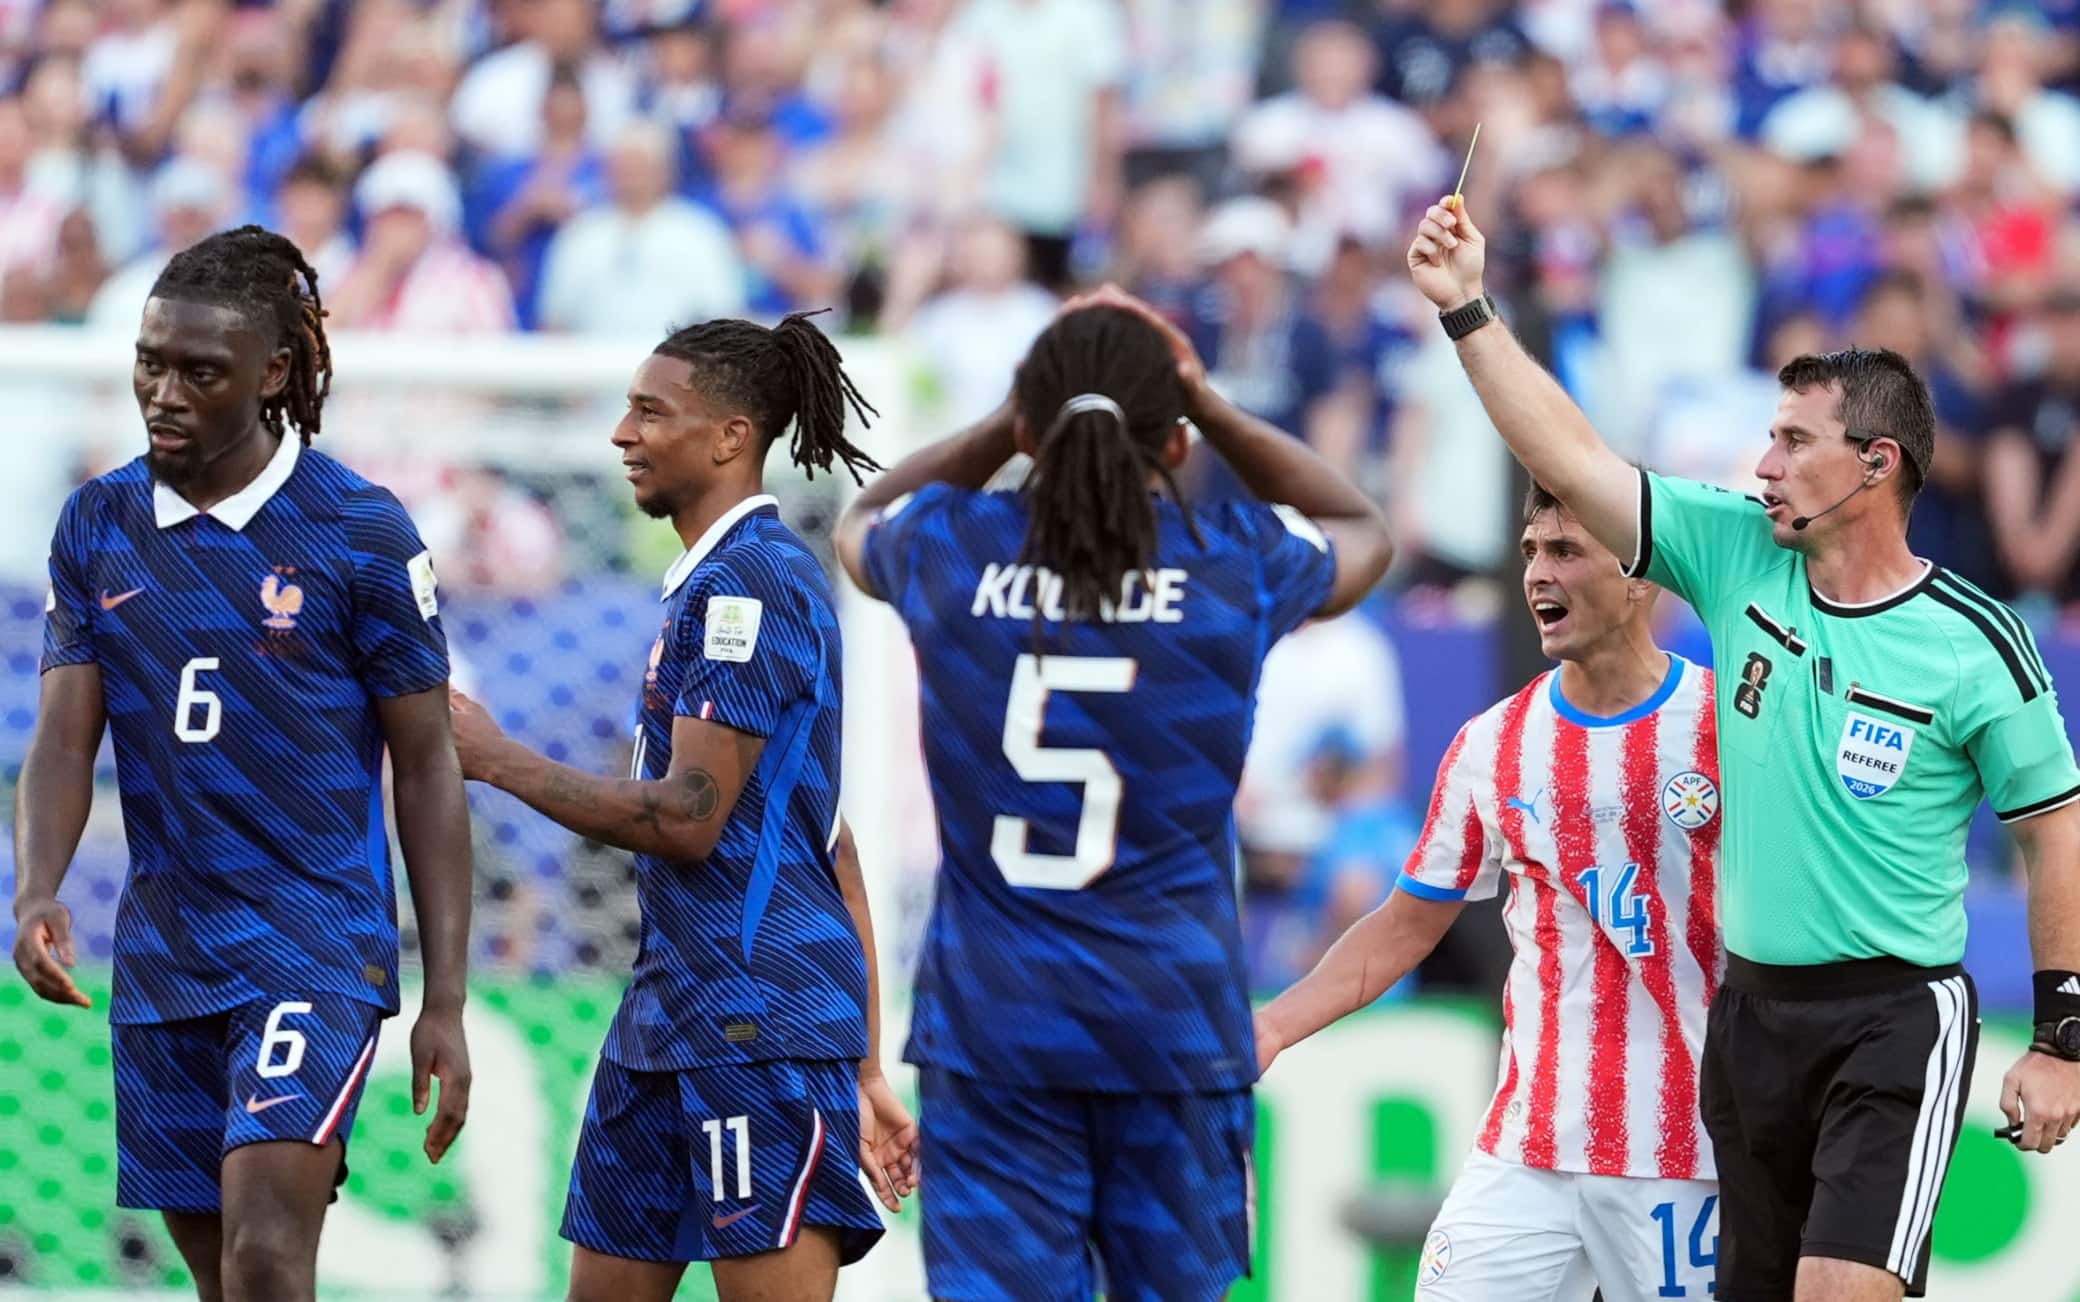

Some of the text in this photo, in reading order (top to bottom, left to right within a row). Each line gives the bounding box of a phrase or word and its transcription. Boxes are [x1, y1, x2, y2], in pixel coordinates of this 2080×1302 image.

[174, 657, 222, 743] 6
[1849, 719, 1903, 751] FIFA
[990, 653, 1138, 890] 5
[1683, 776, 1702, 785] APF
[1842, 750, 1898, 773] REFEREE
[1849, 780, 1876, 794] 2026
[1577, 863, 1656, 957] 14
[256, 1001, 312, 1078] 6
[702, 1115, 752, 1201] 11
[1650, 1194, 1720, 1297] 14
